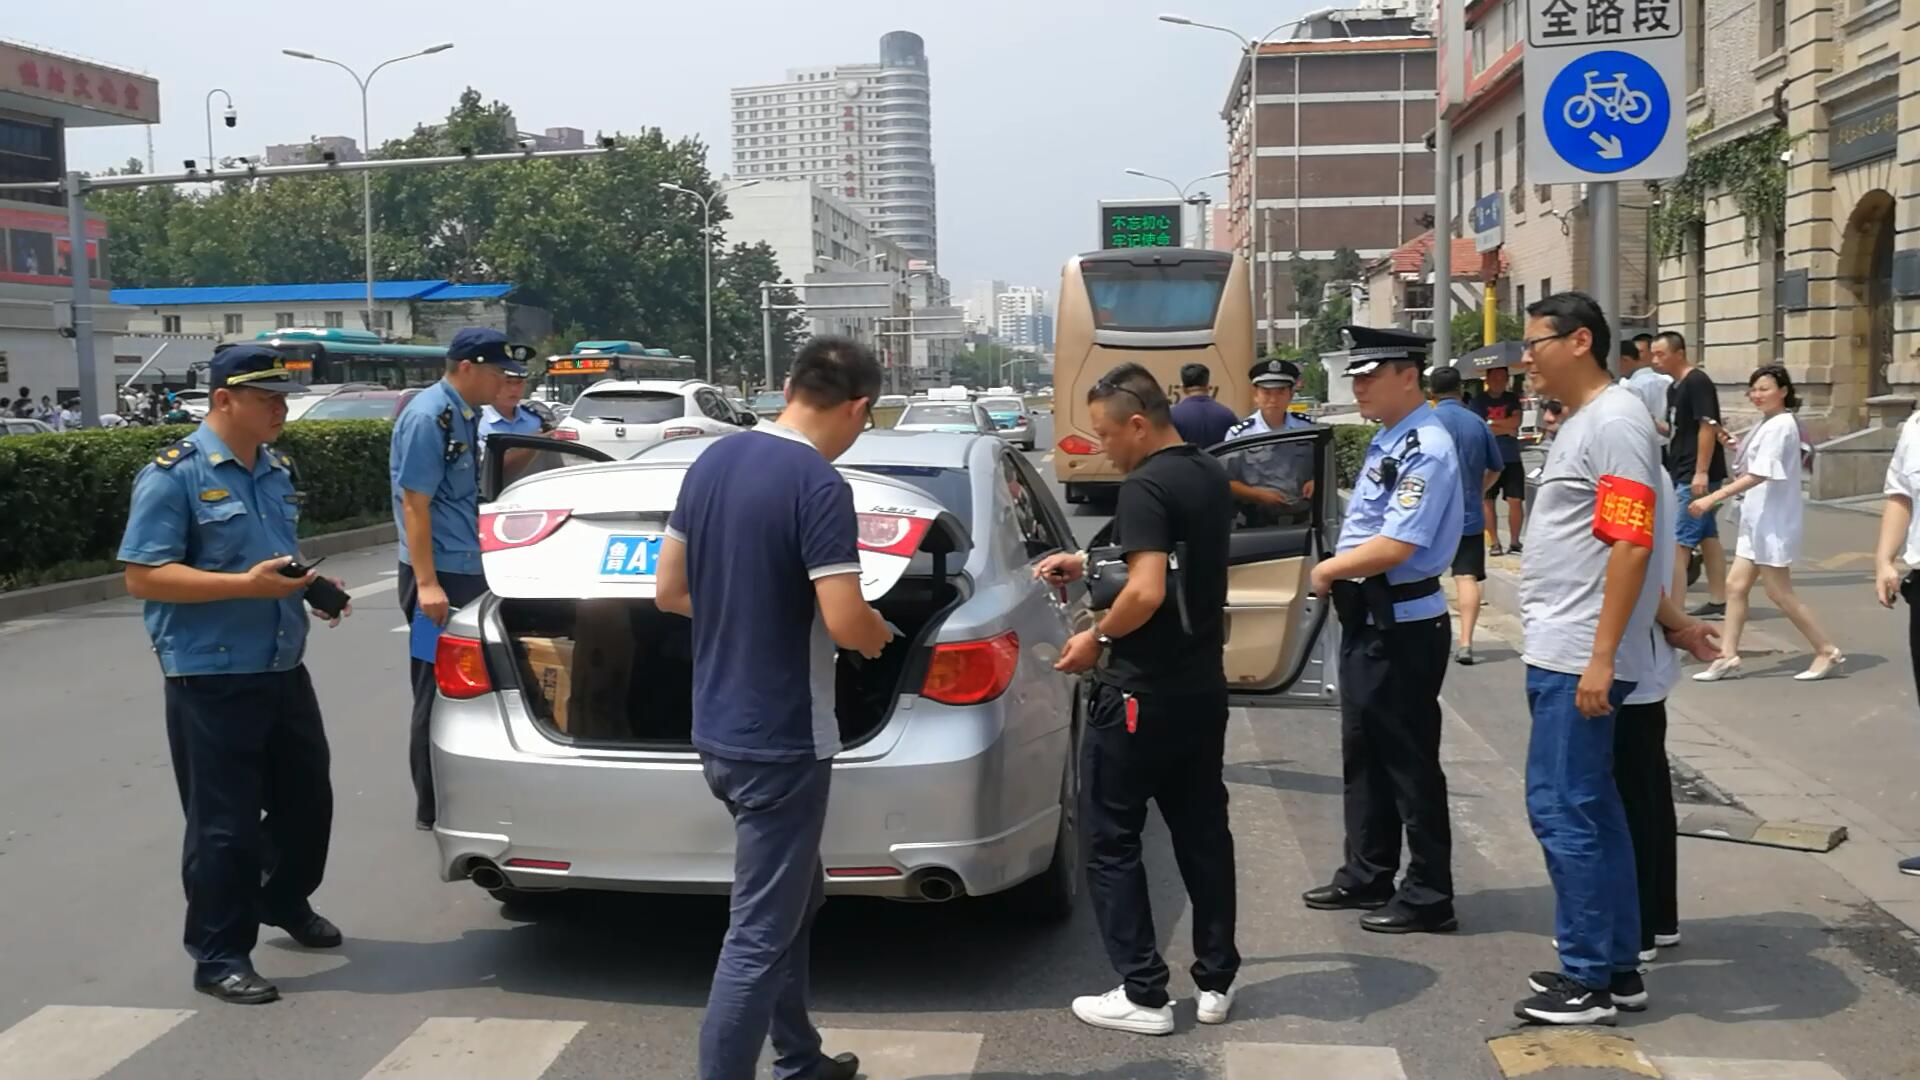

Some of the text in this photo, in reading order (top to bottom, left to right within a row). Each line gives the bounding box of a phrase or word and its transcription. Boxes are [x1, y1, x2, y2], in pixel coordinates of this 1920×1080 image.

[1541, 0, 1672, 37] 全路段
[1111, 214, 1171, 231] 不忘初心
[1111, 232, 1171, 248] 牢记使命
